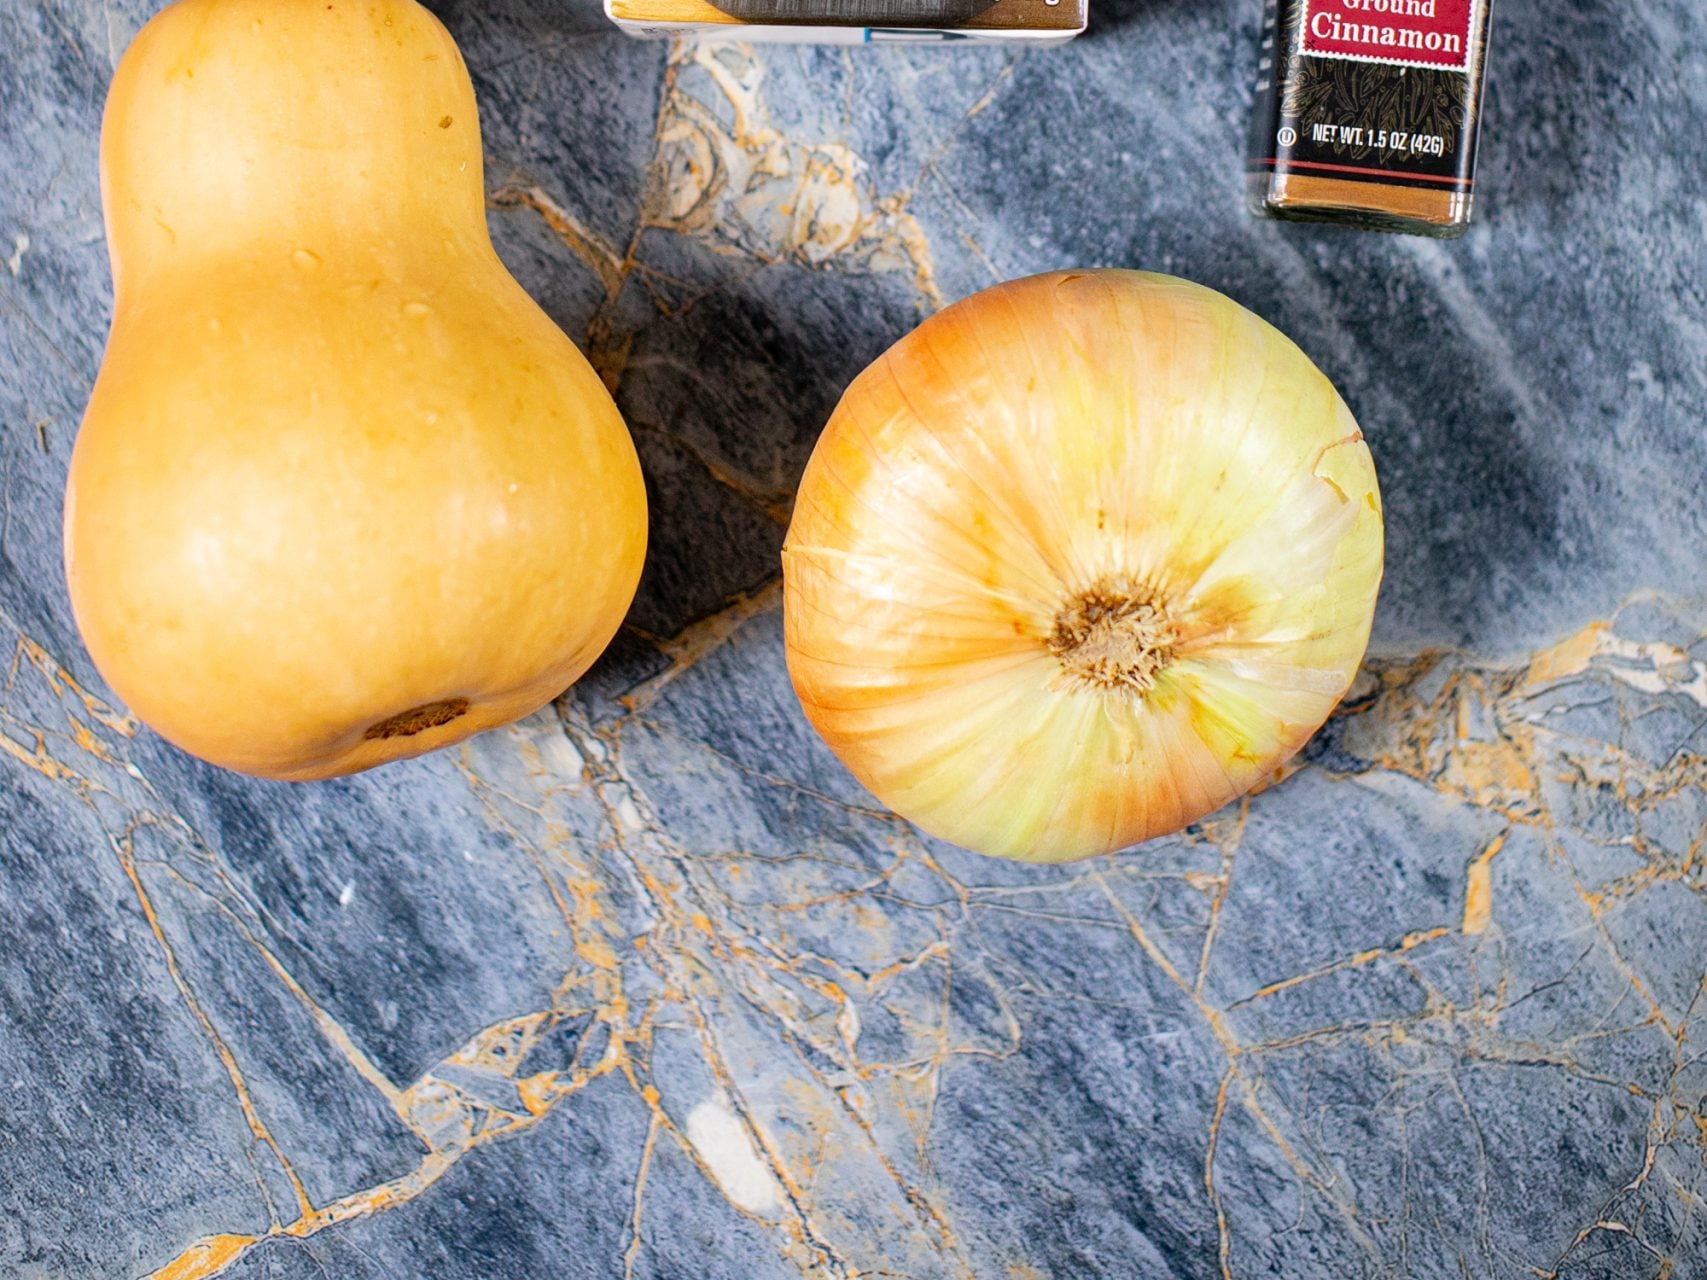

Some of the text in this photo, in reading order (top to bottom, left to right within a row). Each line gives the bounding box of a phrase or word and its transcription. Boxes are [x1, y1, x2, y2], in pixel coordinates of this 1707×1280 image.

[1311, 11, 1461, 53] Cinnamon
[1313, 123, 1444, 157] NET WT. 1.5 OZ (42G)
